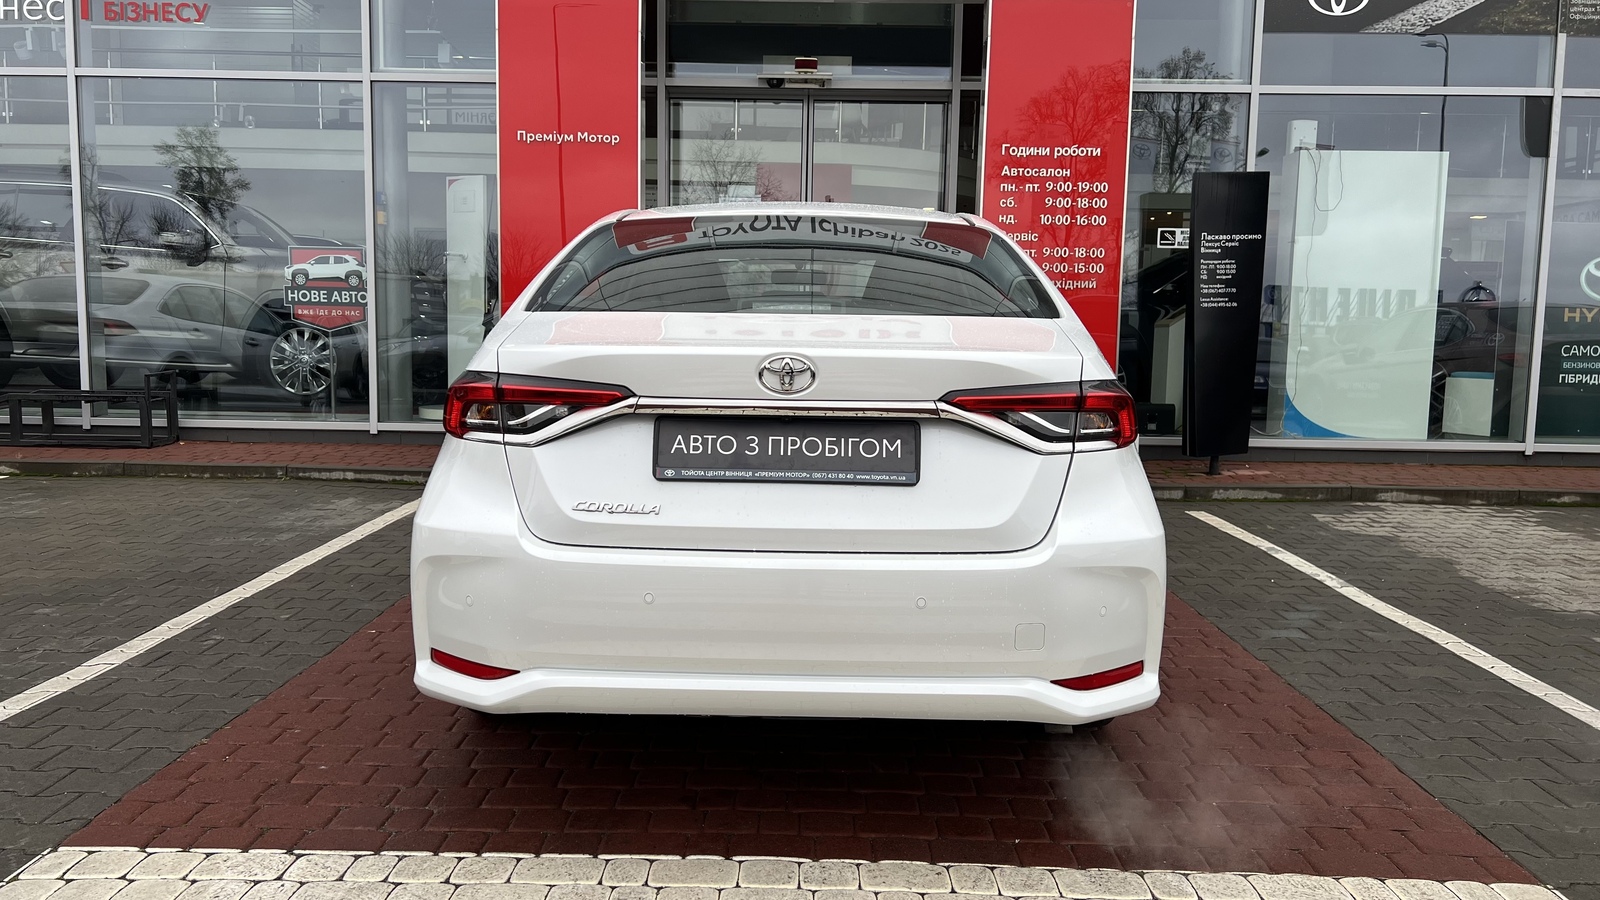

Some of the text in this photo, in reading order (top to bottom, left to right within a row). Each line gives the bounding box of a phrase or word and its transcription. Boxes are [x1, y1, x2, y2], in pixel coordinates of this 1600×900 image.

[104, 2, 209, 23] БІЗНЕСУ
[517, 130, 620, 145] Преміум Мотор
[1001, 144, 1101, 158] Години роботи
[1001, 166, 1070, 177] Автосалон
[1045, 182, 1108, 193] 9:00-19:00
[1000, 197, 1108, 208] сб. 9:00-18:00
[999, 214, 1107, 226] нд. 10:00-16:00
[1003, 230, 1038, 242] ервіс
[1201, 232, 1231, 241] Ласкаво
[1042, 246, 1105, 259] 9:00-18:00
[1042, 262, 1104, 274] 9:00-15:00
[1050, 278, 1097, 290] хідний
[288, 290, 368, 304] НОВЕ АВТО
[316, 308, 328, 316] ЇДЕ
[1564, 308, 1600, 323] HY
[1561, 345, 1600, 357] САМО
[1559, 374, 1600, 385] ГІБРИД
[671, 434, 902, 458] АВТО З ПРОБІГОМ
[705, 470, 725, 478] ЦЕНТР
[572, 499, 661, 516] COROLLA
